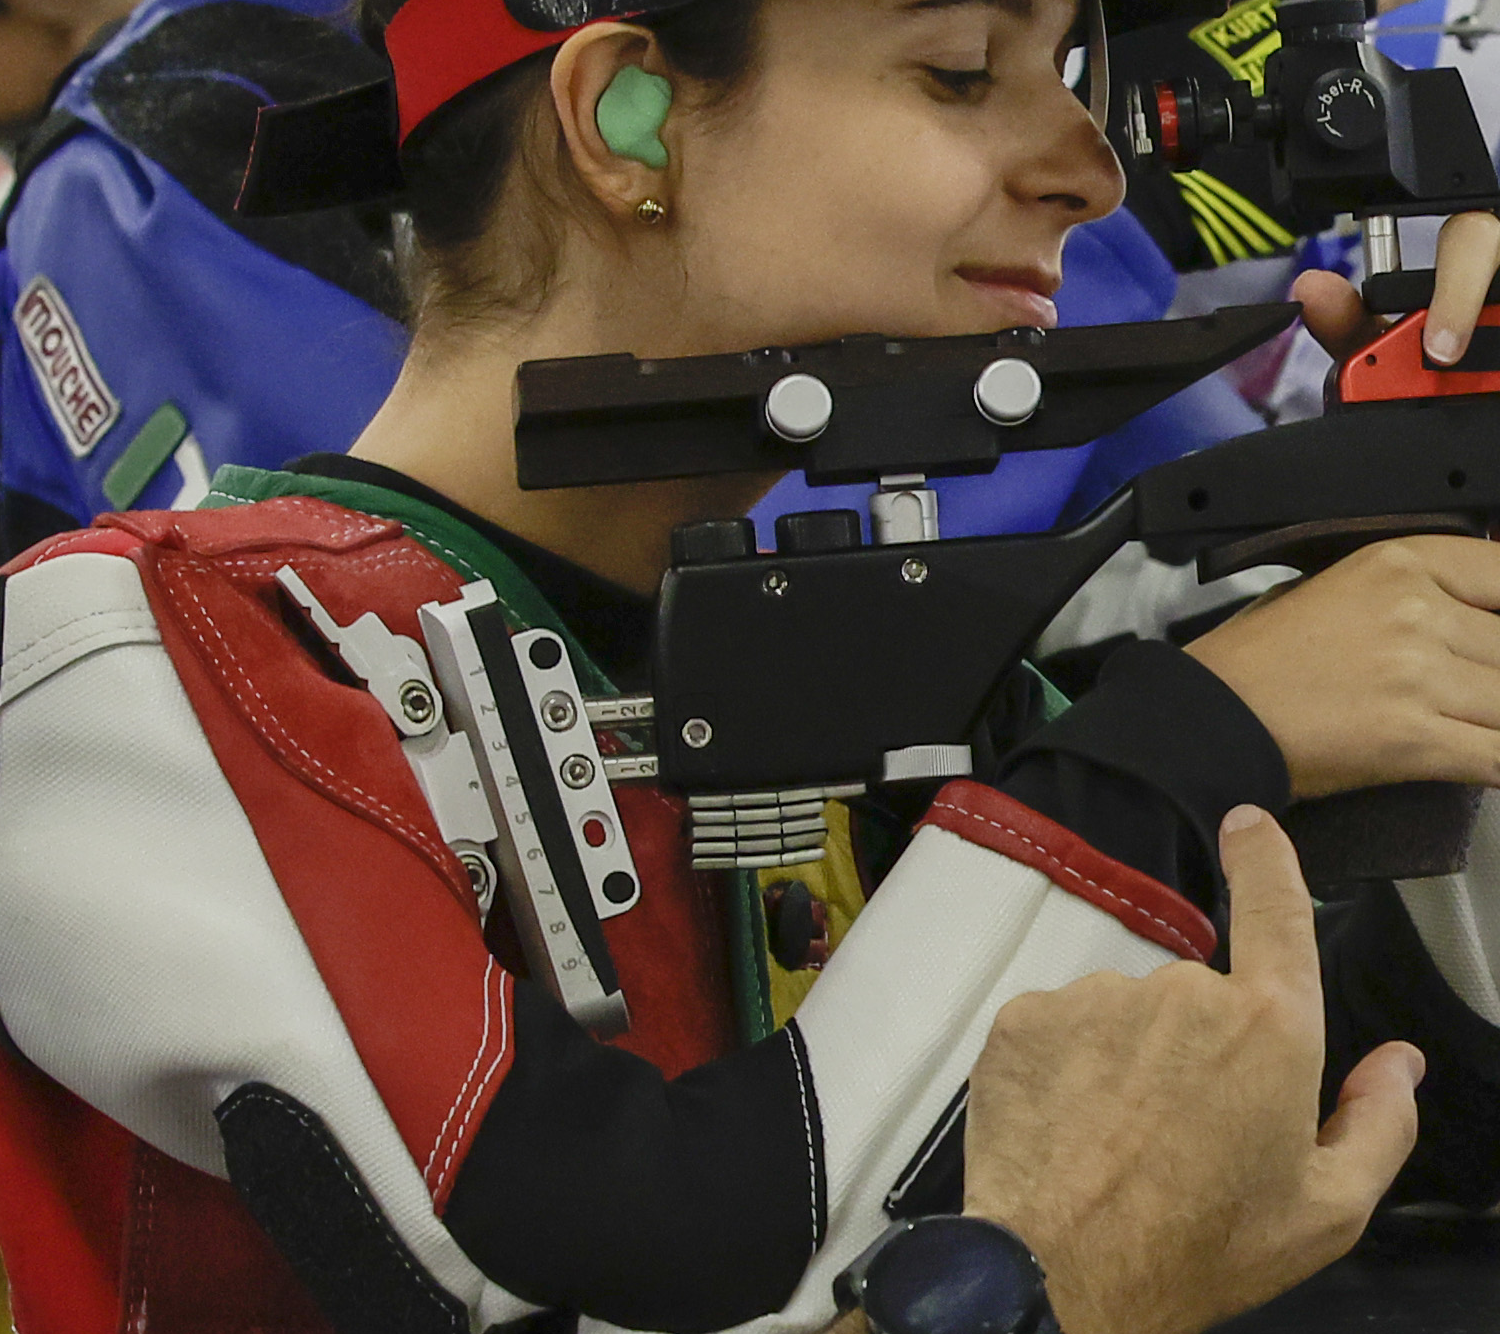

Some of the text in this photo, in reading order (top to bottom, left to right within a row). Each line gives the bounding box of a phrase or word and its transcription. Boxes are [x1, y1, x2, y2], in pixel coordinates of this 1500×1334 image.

[505, 775, 521, 788] 4
[515, 812, 532, 825] 5
[527, 848, 543, 861] 6
[538, 884, 554, 896] 7
[550, 921, 566, 934] 8
